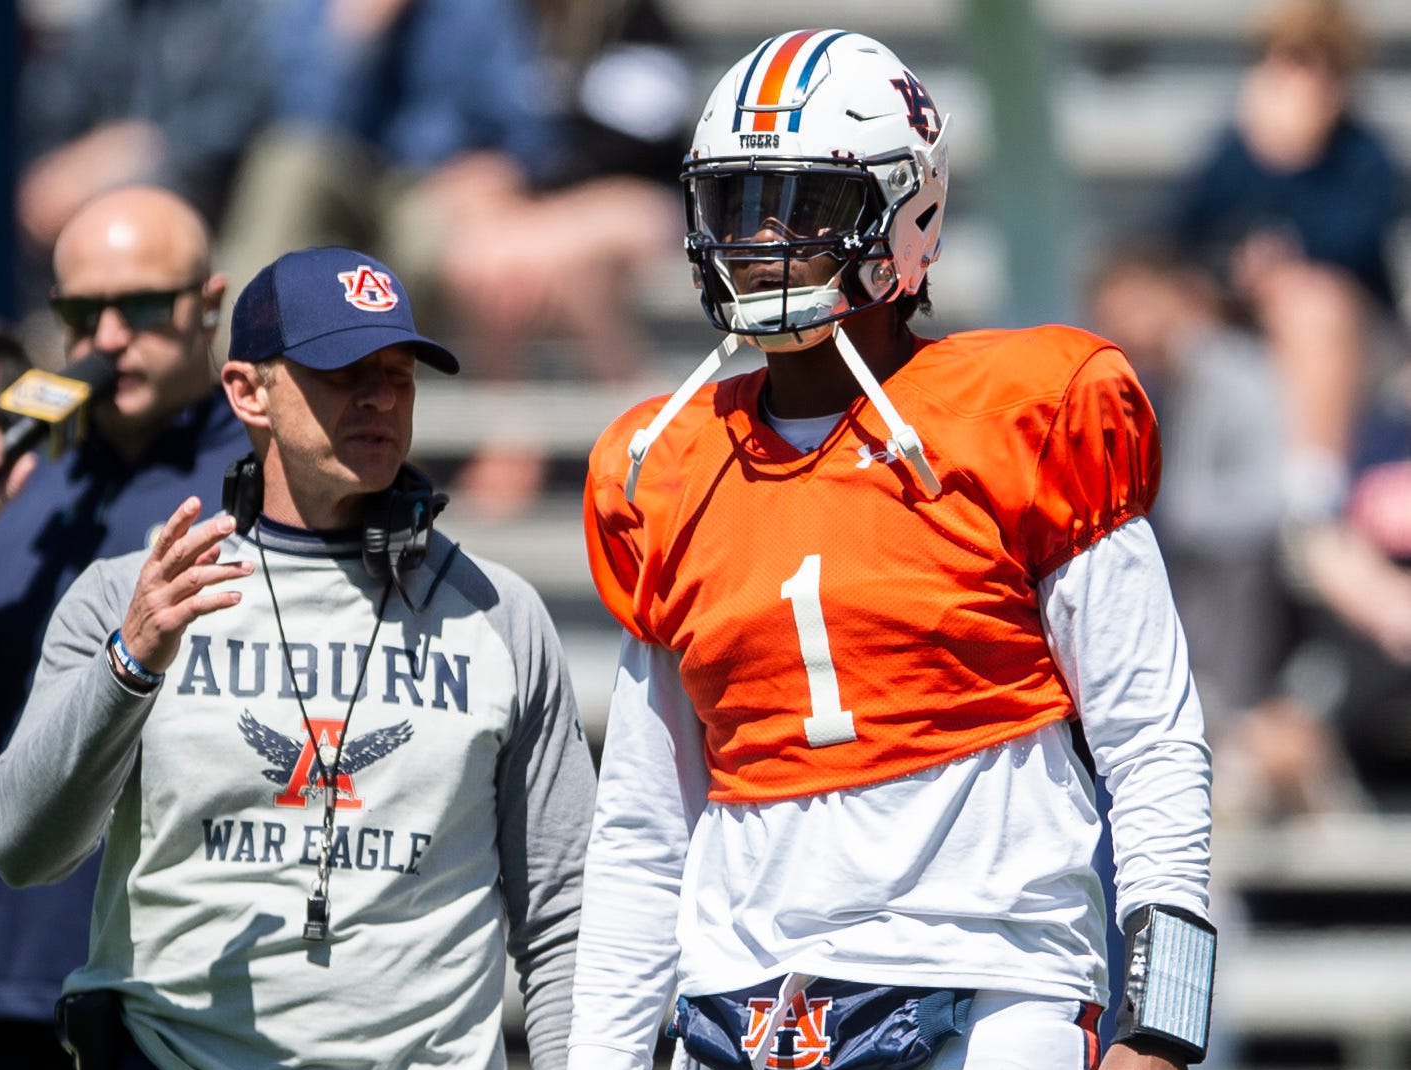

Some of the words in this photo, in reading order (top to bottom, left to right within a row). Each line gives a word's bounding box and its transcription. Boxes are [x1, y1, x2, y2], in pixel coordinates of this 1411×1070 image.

[739, 134, 780, 149] TIGERS
[177, 635, 470, 713] AUBURN
[781, 554, 858, 748] 1
[202, 818, 287, 863] WAR
[299, 824, 432, 876] EAGLE
